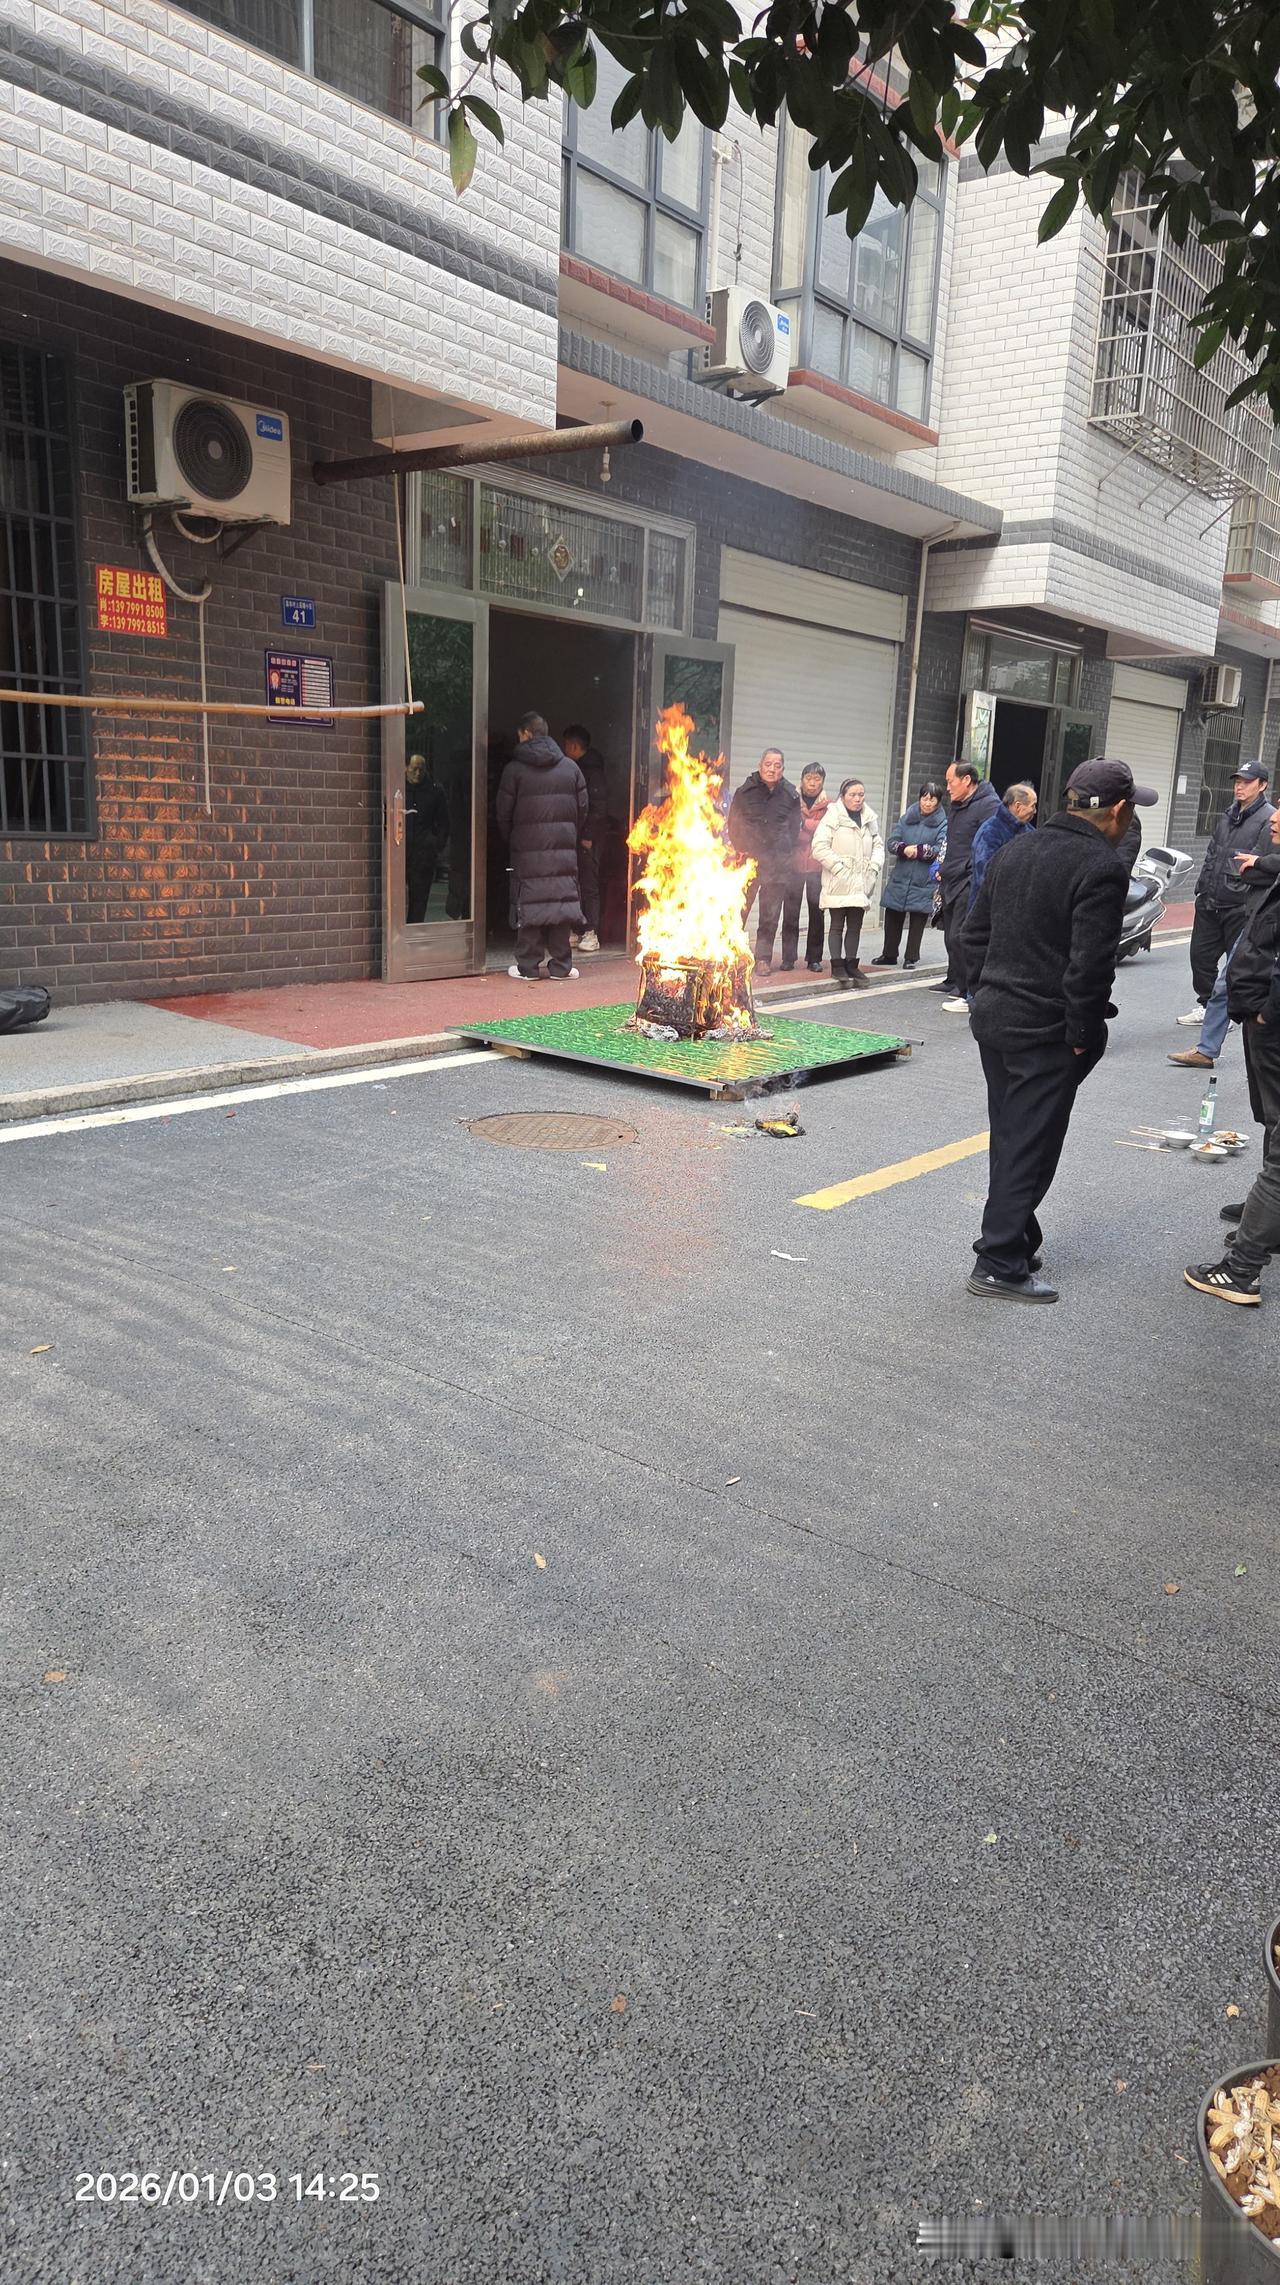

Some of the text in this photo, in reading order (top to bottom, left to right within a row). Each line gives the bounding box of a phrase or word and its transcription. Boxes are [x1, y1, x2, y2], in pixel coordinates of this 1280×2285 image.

[99, 568, 164, 603] 房屋出租
[292, 609, 305, 623] 41
